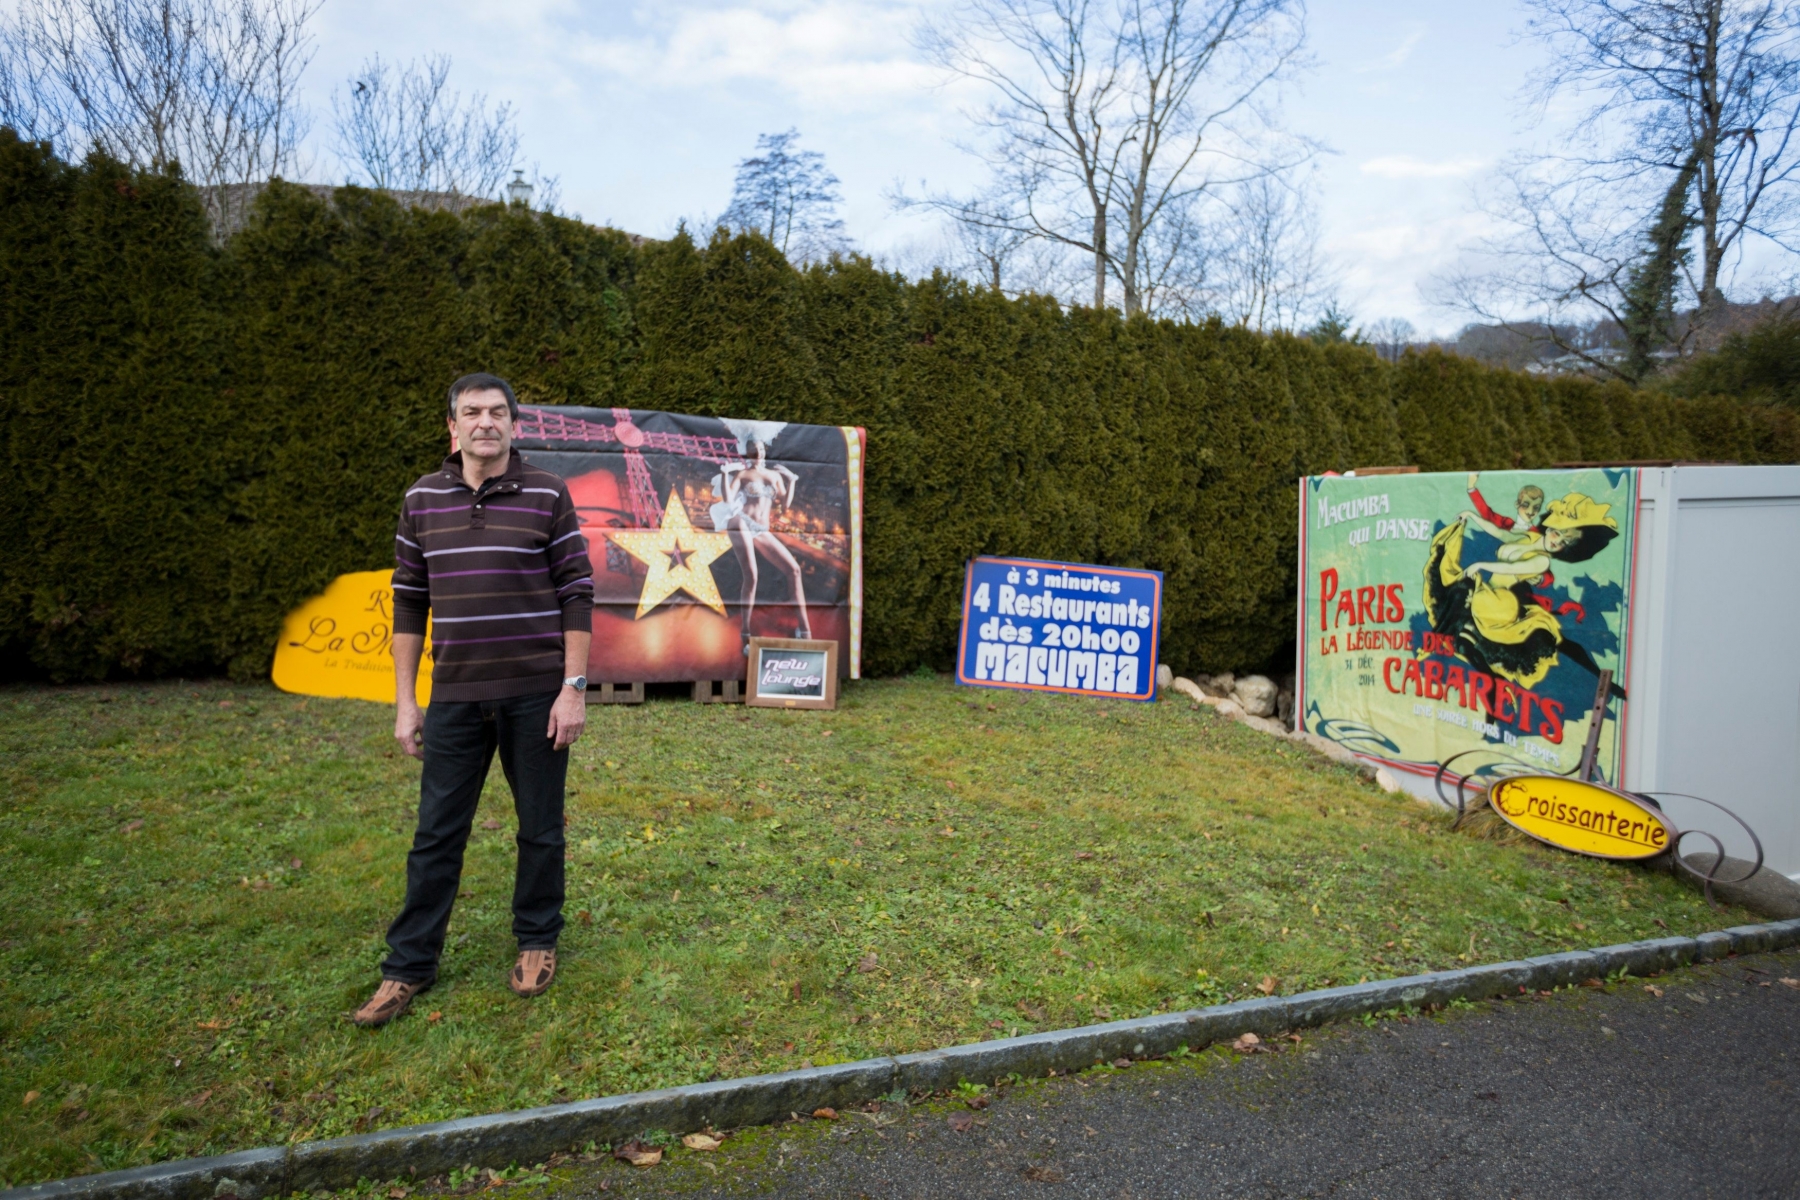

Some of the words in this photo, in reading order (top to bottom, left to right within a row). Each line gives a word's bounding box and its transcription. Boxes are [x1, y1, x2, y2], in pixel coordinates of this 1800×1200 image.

[1375, 518, 1431, 541] DANSE
[1007, 566, 1020, 584] à
[1025, 568, 1039, 586] 3
[1044, 571, 1121, 594] minutes
[1320, 567, 1405, 631] PARIS
[973, 582, 990, 613] 4
[998, 584, 1150, 629] Restaurants
[289, 615, 346, 654] La
[979, 616, 1033, 644] dès
[1041, 623, 1140, 654] 20h00
[1321, 635, 1338, 656] LA
[1346, 626, 1415, 652] LÉGENDE
[1422, 631, 1455, 657] DES
[761, 669, 821, 687] lounge
[765, 658, 808, 672] new
[1358, 674, 1376, 686] 2014
[1383, 657, 1564, 744] CABARETS
[1412, 703, 1433, 719] UNE
[1436, 708, 1468, 729] SOIRÉE
[1471, 719, 1502, 741] HORS
[1503, 730, 1519, 748] DU
[1522, 740, 1561, 768] TEMPS
[1495, 780, 1665, 846] Croissanterie
